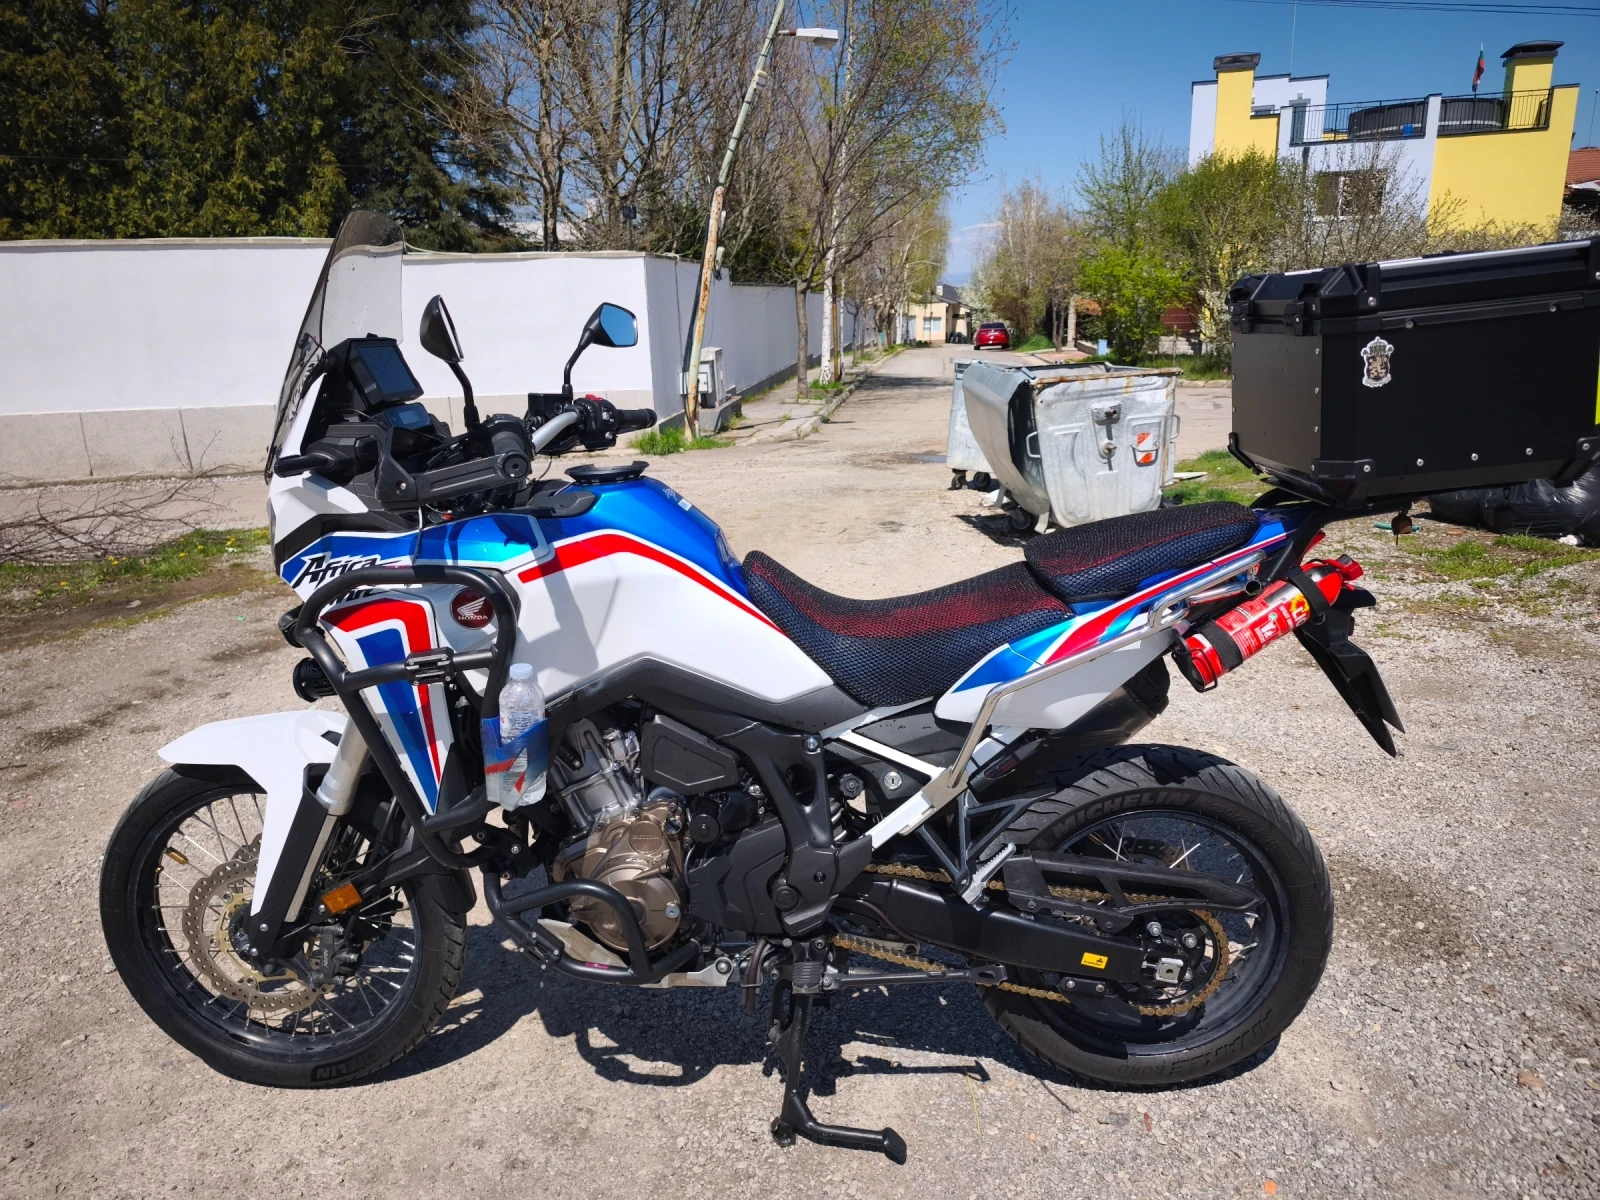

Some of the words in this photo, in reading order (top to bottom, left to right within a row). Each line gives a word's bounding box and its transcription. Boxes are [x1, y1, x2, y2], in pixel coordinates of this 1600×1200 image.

[291, 554, 402, 590] Africa
[1052, 791, 1190, 839] MICHELIN
[1117, 1064, 1166, 1077] ROAD
